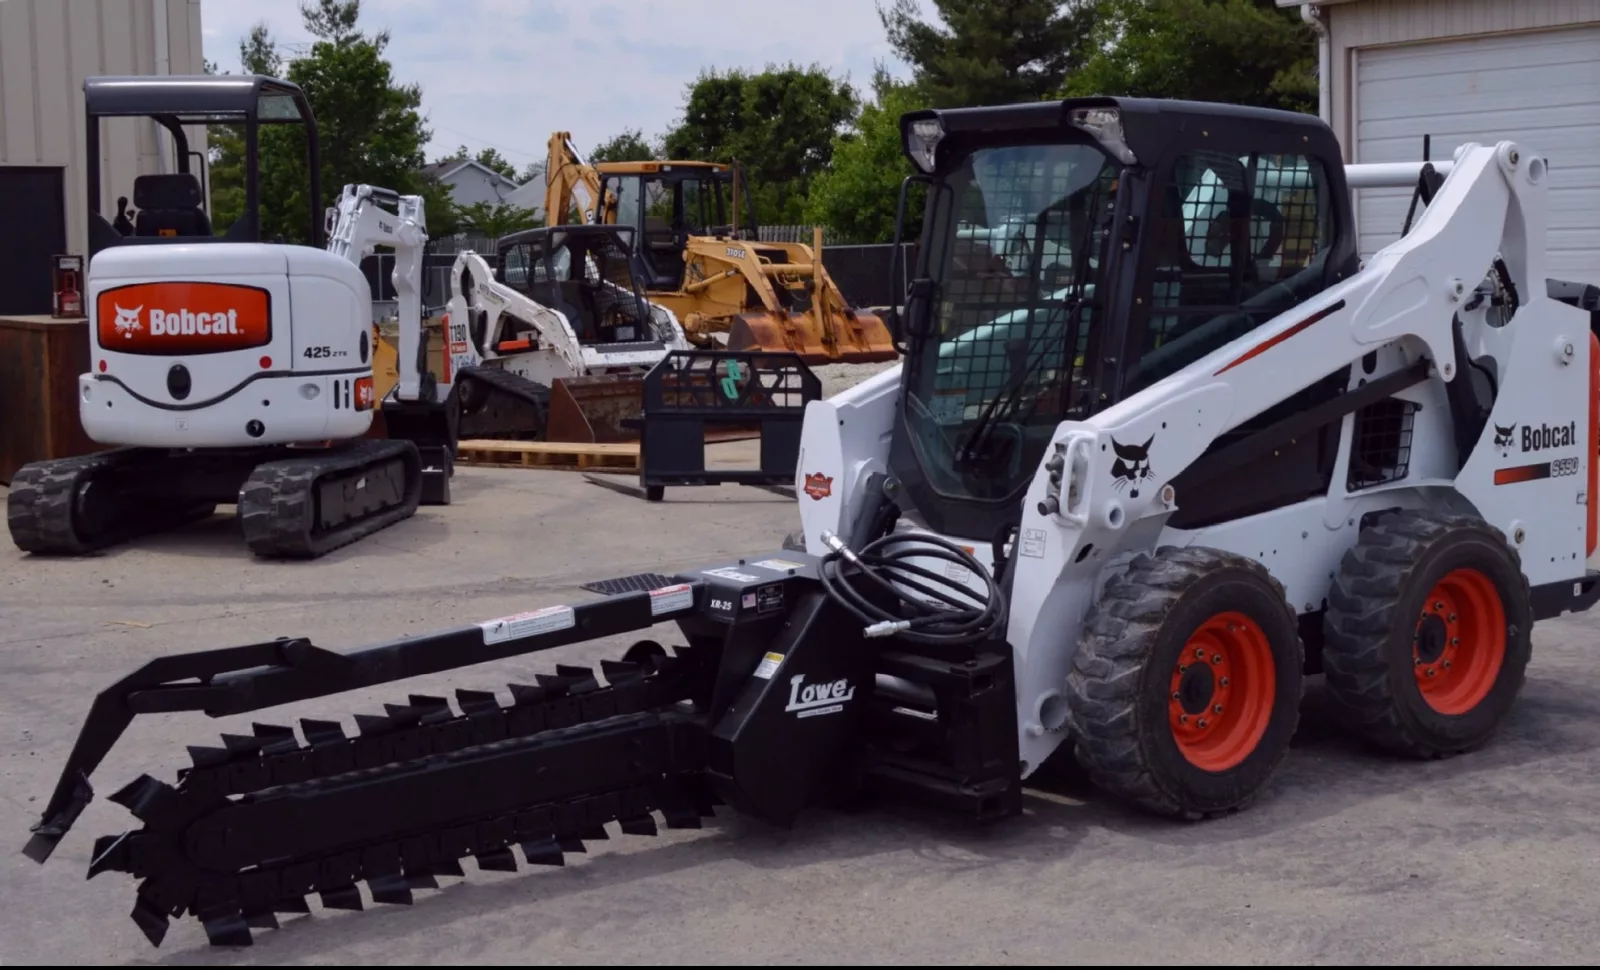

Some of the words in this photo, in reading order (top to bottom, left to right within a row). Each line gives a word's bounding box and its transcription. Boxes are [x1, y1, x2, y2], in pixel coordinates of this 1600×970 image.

[150, 308, 238, 336] Bobcat
[303, 346, 331, 359] 425
[1521, 421, 1576, 452] Bobcat
[1552, 457, 1579, 478] S590
[710, 599, 732, 611] XR-25
[785, 674, 855, 712] Lowe
